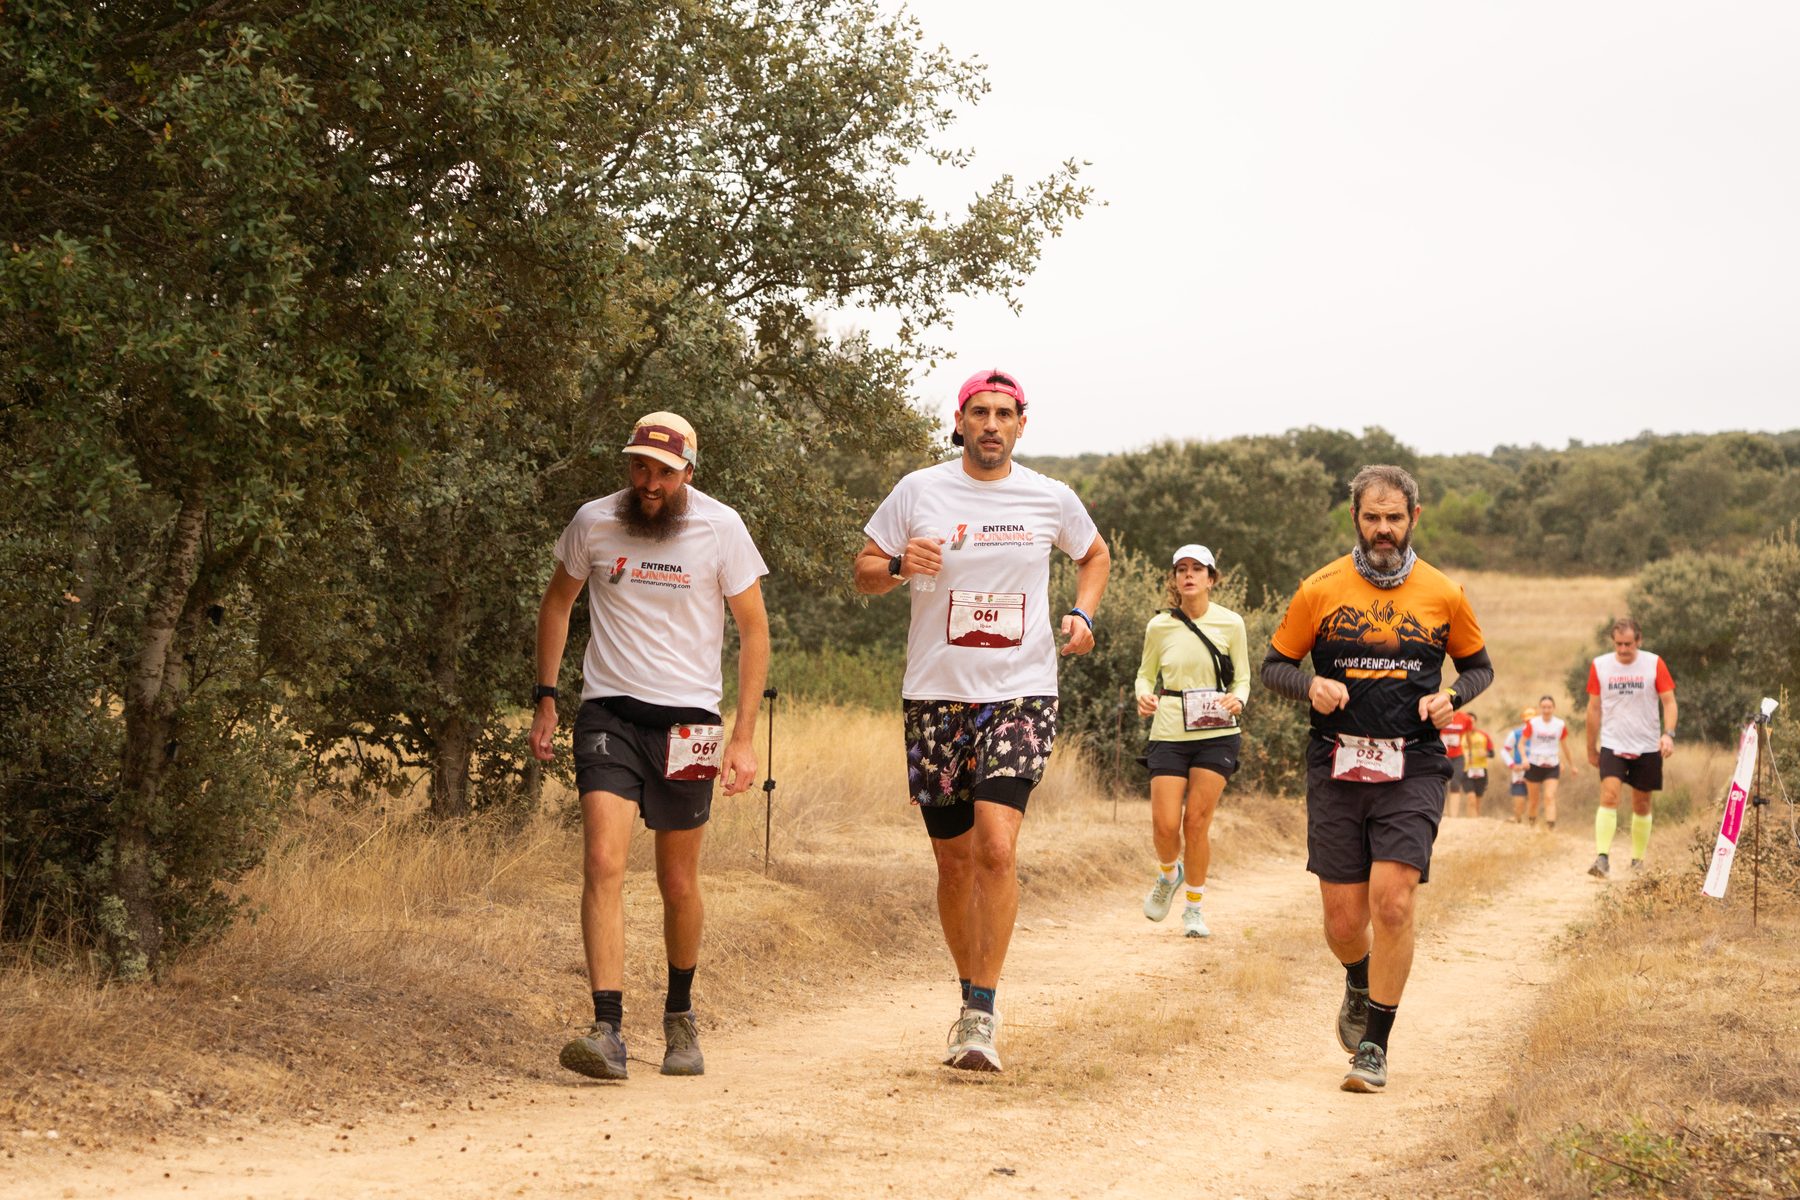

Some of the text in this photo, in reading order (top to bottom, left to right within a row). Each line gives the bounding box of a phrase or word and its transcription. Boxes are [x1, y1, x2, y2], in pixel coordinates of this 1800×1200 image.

[982, 524, 1025, 533] ENTRENA
[973, 532, 1034, 542] RUNNING
[640, 561, 682, 573] ENTRENA
[631, 568, 691, 584] RUNNING
[630, 578, 691, 589] entrenarunning.com
[973, 609, 999, 622] 061
[692, 742, 718, 755] 069
[1356, 748, 1384, 761] 082
